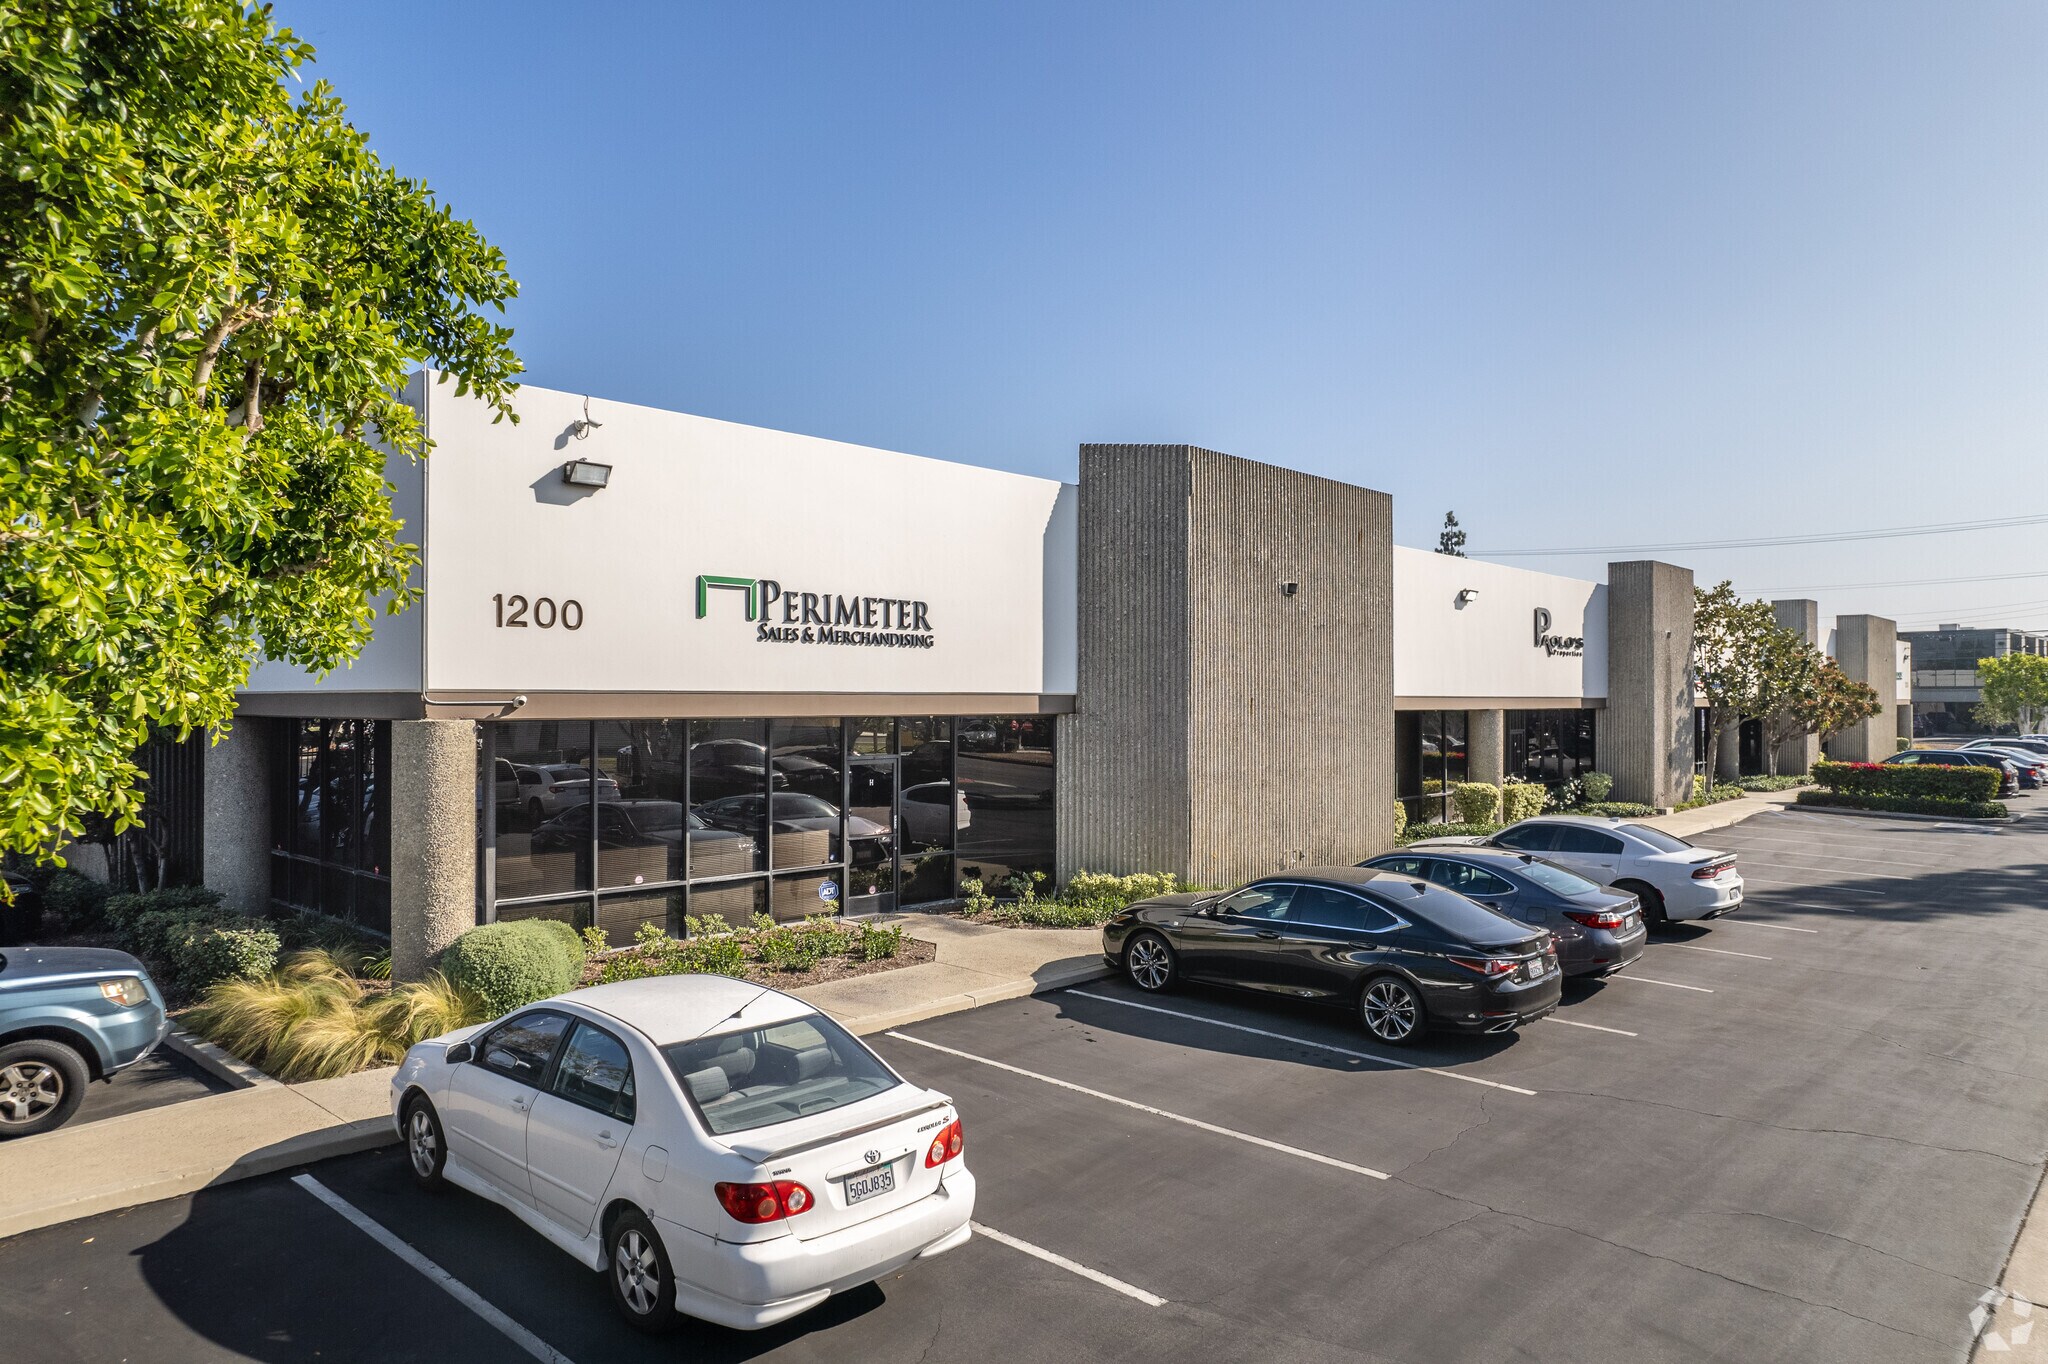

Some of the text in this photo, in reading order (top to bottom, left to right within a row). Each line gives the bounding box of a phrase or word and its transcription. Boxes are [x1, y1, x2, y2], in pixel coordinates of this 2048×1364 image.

[492, 593, 584, 631] 1200
[758, 579, 933, 632] PERIMETER
[756, 622, 935, 650] SALES & MERCHANDISING
[822, 887, 836, 896] ADT
